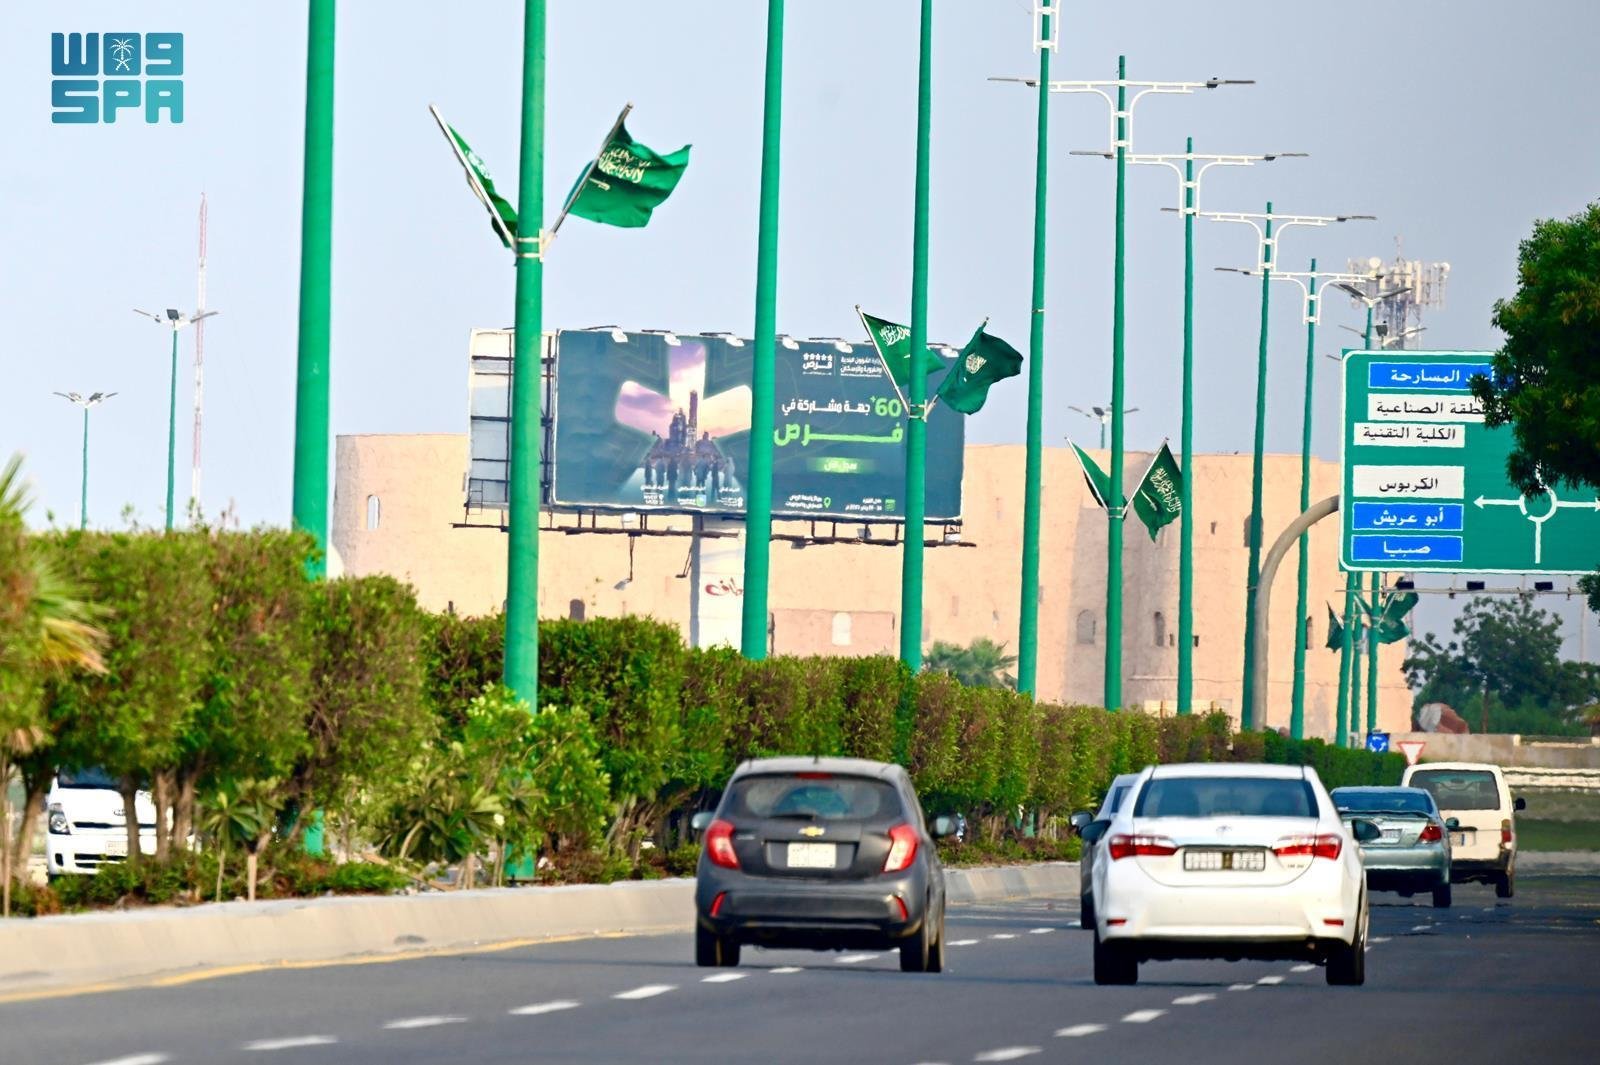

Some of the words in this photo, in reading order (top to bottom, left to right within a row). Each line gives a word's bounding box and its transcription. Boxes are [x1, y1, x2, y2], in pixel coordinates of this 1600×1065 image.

[1391, 368, 1460, 384] المسارحة
[782, 398, 796, 416] في
[797, 399, 843, 414] مشاركة
[844, 400, 871, 415] جهة
[1376, 402, 1444, 416] الصناعية
[1363, 426, 1410, 441] التقنية
[1416, 427, 1456, 443] الكلية
[1379, 477, 1438, 493] الكربوس
[1373, 509, 1418, 526] عريش
[1425, 506, 1444, 527] أبو
[1383, 540, 1431, 558] صبيا
